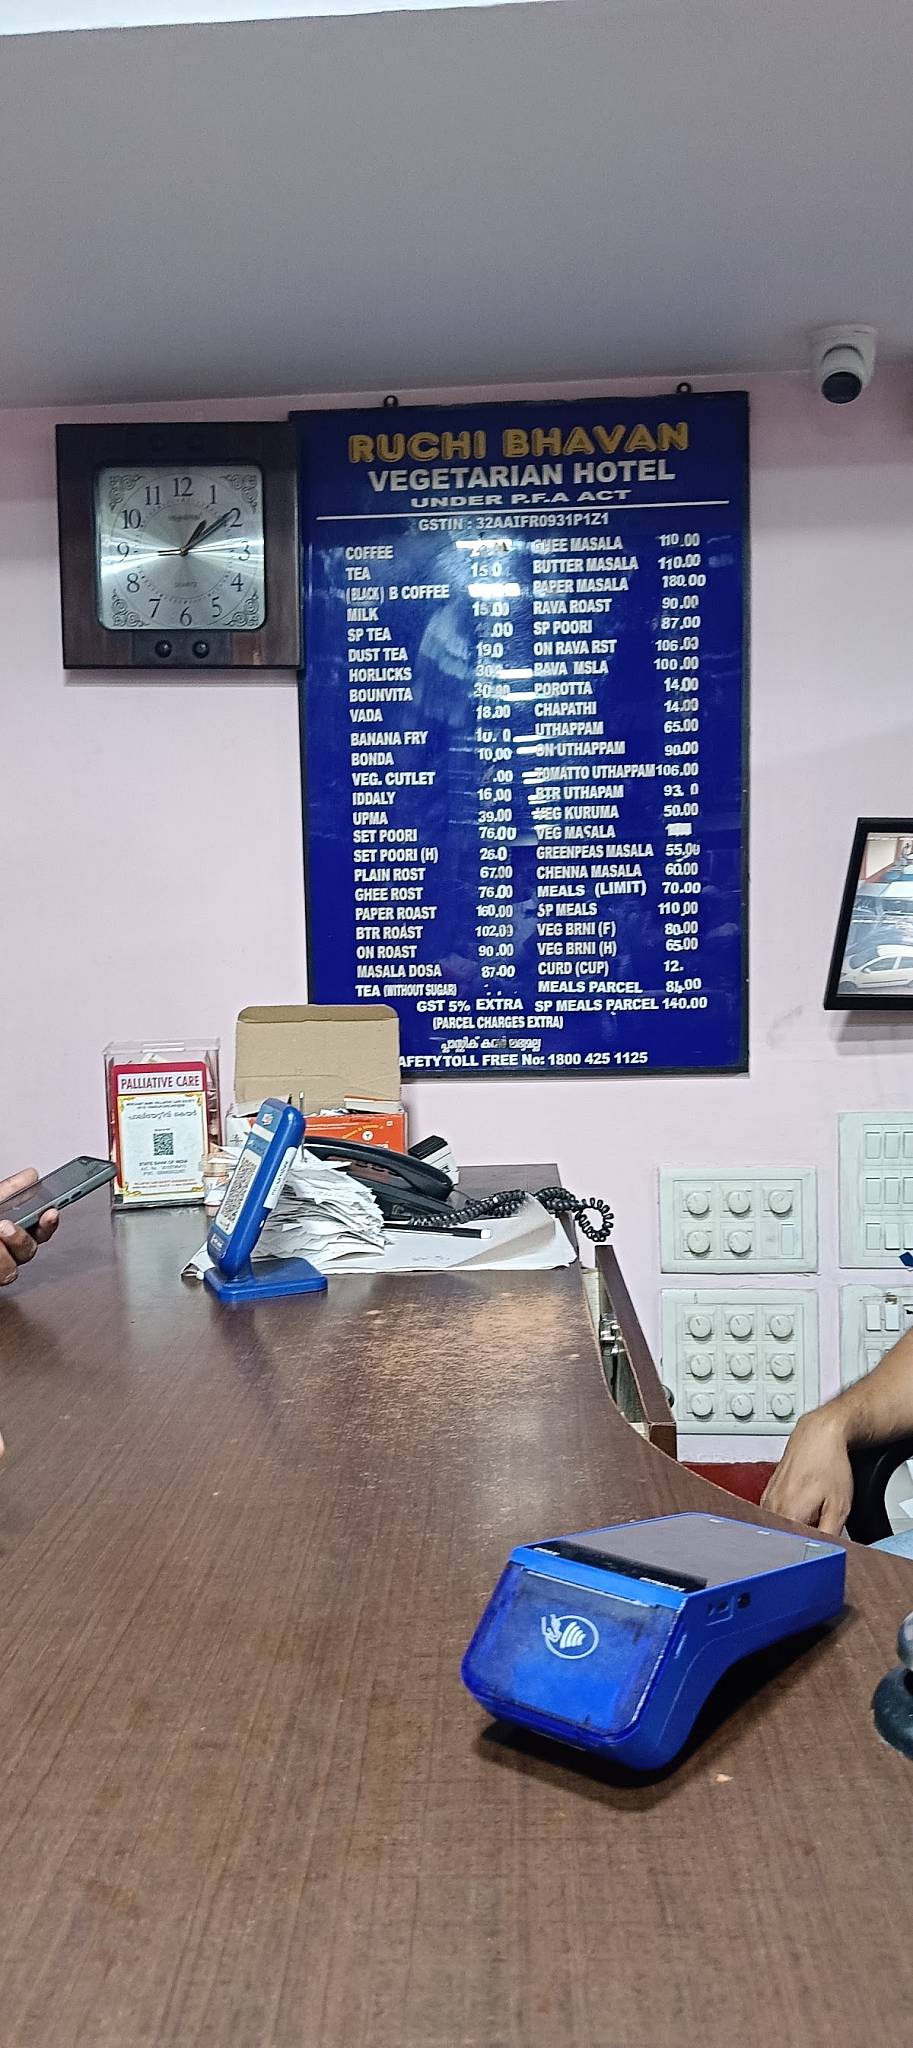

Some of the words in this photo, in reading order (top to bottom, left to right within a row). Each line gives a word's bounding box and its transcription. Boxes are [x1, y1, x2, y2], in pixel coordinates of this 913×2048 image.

[348, 430, 487, 463] RUCHI
[503, 422, 688, 458] BHAVAN
[368, 464, 563, 492] VEGETARIAN
[573, 459, 676, 484] HOTEL
[173, 477, 193, 496] 12
[210, 485, 217, 504] 1
[145, 487, 161, 505] 11
[411, 495, 503, 508] UNDER
[577, 490, 632, 501] ACT
[121, 509, 141, 529] 10
[230, 508, 242, 527] 2
[418, 519, 463, 531] GSTIN
[533, 538, 568, 553] GHEE
[570, 536, 623, 551] MASALA
[659, 533, 700, 547] 110.00
[117, 542, 130, 562] 9
[239, 542, 250, 561] 3
[345, 546, 393, 560] COFFEE
[533, 559, 584, 574] BUTTER
[586, 557, 639, 571] MASALA
[658, 554, 701, 570] 110.00
[345, 567, 371, 580] TEA
[127, 573, 140, 593] 8
[231, 573, 243, 592] 4
[533, 579, 574, 595] PAPER
[576, 578, 628, 592] MASALA
[662, 574, 706, 588] 180.00
[389, 586, 398, 600] B
[401, 585, 450, 599] COFFEE
[149, 598, 160, 618] 7
[211, 597, 222, 617] 5
[533, 600, 567, 615] RAVA
[570, 599, 612, 613] ROAST
[662, 595, 699, 610] 90.00
[180, 607, 192, 626] 6
[347, 607, 378, 621] MILK
[533, 621, 550, 635] SP
[553, 620, 592, 634] POORI
[661, 616, 701, 630] 87.00
[348, 629, 364, 642] SP
[367, 628, 392, 641] TEA
[348, 649, 380, 662] DUST
[382, 648, 408, 661] TEA
[534, 642, 553, 655] ON
[556, 641, 589, 654] RAVA
[592, 640, 617, 653] RST
[573, 661, 608, 674] MSLA
[654, 656, 699, 671] 100.00
[349, 668, 412, 682] HORLICKS
[534, 681, 593, 696] POROTTA
[664, 677, 698, 692] 14.00
[349, 688, 413, 702] BOUNVITA
[350, 709, 383, 722] VADA
[535, 702, 597, 716] CHAPATHI
[535, 722, 603, 736] UTHAPPAM
[664, 718, 698, 733] 65.00
[350, 732, 401, 746] BANANA
[404, 731, 428, 745] FRY
[558, 741, 625, 756] UTHAPPAM
[664, 741, 698, 756] 90.00
[351, 752, 394, 766] BONDA
[592, 764, 655, 778] UTHAPPAM
[656, 762, 698, 776] 106.00
[352, 772, 382, 786] VEG.
[385, 772, 436, 785] CUTLET
[352, 792, 396, 805] IDDALY
[564, 785, 624, 799] UTHAPAM
[352, 812, 388, 825] UPMA
[478, 809, 512, 823] 39.00
[565, 805, 619, 819] KURUMA
[663, 803, 698, 818] 50.00
[353, 830, 377, 843] SET
[379, 829, 417, 842] POORI
[536, 826, 561, 840] VEG
[565, 825, 616, 839] MASALA
[353, 849, 378, 862] SET
[380, 848, 418, 862] POORI
[421, 847, 438, 863] (H)
[537, 845, 603, 859] GREENPEAS
[606, 844, 654, 858] MASALA
[354, 869, 390, 882] PLAIN
[393, 868, 426, 881] ROST
[480, 866, 513, 878] 67.00
[537, 865, 588, 879] CHENNA
[591, 864, 642, 878] MASALA
[665, 862, 698, 876] 60.00
[355, 888, 389, 901] GHEE
[391, 887, 423, 900] ROST
[478, 885, 513, 898] 76.00
[538, 885, 585, 897] MEALS
[595, 880, 646, 898] (LIMIT)
[662, 882, 701, 894] 70.00
[355, 908, 394, 920] PAPER
[397, 907, 437, 920] ROAST
[476, 905, 513, 918] 160.00
[537, 903, 553, 917] SP
[556, 903, 598, 916] MEALS
[356, 927, 381, 939] BTR
[383, 926, 423, 939] ROAST
[537, 922, 563, 936] VEG
[565, 922, 595, 935] BRNI
[598, 921, 616, 938] (F)
[665, 921, 698, 936] 80.00
[357, 947, 374, 959] ON
[377, 945, 417, 958] ROAST
[478, 944, 513, 957] 90.00
[537, 942, 563, 955] VEG
[566, 942, 596, 955] BRNI
[599, 940, 617, 957] (H)
[665, 937, 698, 952] 65.00
[357, 966, 406, 978] MASALA
[409, 965, 442, 978] DOSA
[538, 961, 572, 975] CURD
[575, 961, 609, 977] (CUP)
[355, 985, 381, 997] TEA
[384, 985, 423, 997] (WITHOUT
[426, 984, 457, 996] SUGAR)
[538, 981, 586, 993] MEALS
[589, 981, 643, 993] PARCEL
[417, 1000, 446, 1012] GST
[448, 1000, 470, 1012] 5%
[476, 998, 523, 1011] EXTRA
[535, 1000, 552, 1012] SP
[556, 999, 602, 1012] MEALS
[606, 998, 659, 1011] PARCEL
[662, 997, 708, 1010] 140.00
[433, 1016, 475, 1030] (PARCEL
[477, 1016, 525, 1028] CHARGES
[527, 1015, 563, 1029] EXTRA)
[443, 1056, 479, 1067] TOLL
[482, 1055, 518, 1066] FREE
[522, 1053, 545, 1065] No:
[548, 1053, 581, 1065] 1800
[585, 1053, 610, 1064] 425
[614, 1052, 648, 1064] 1125
[121, 1076, 173, 1090] PALLIATIVE
[176, 1075, 200, 1087] CARE
